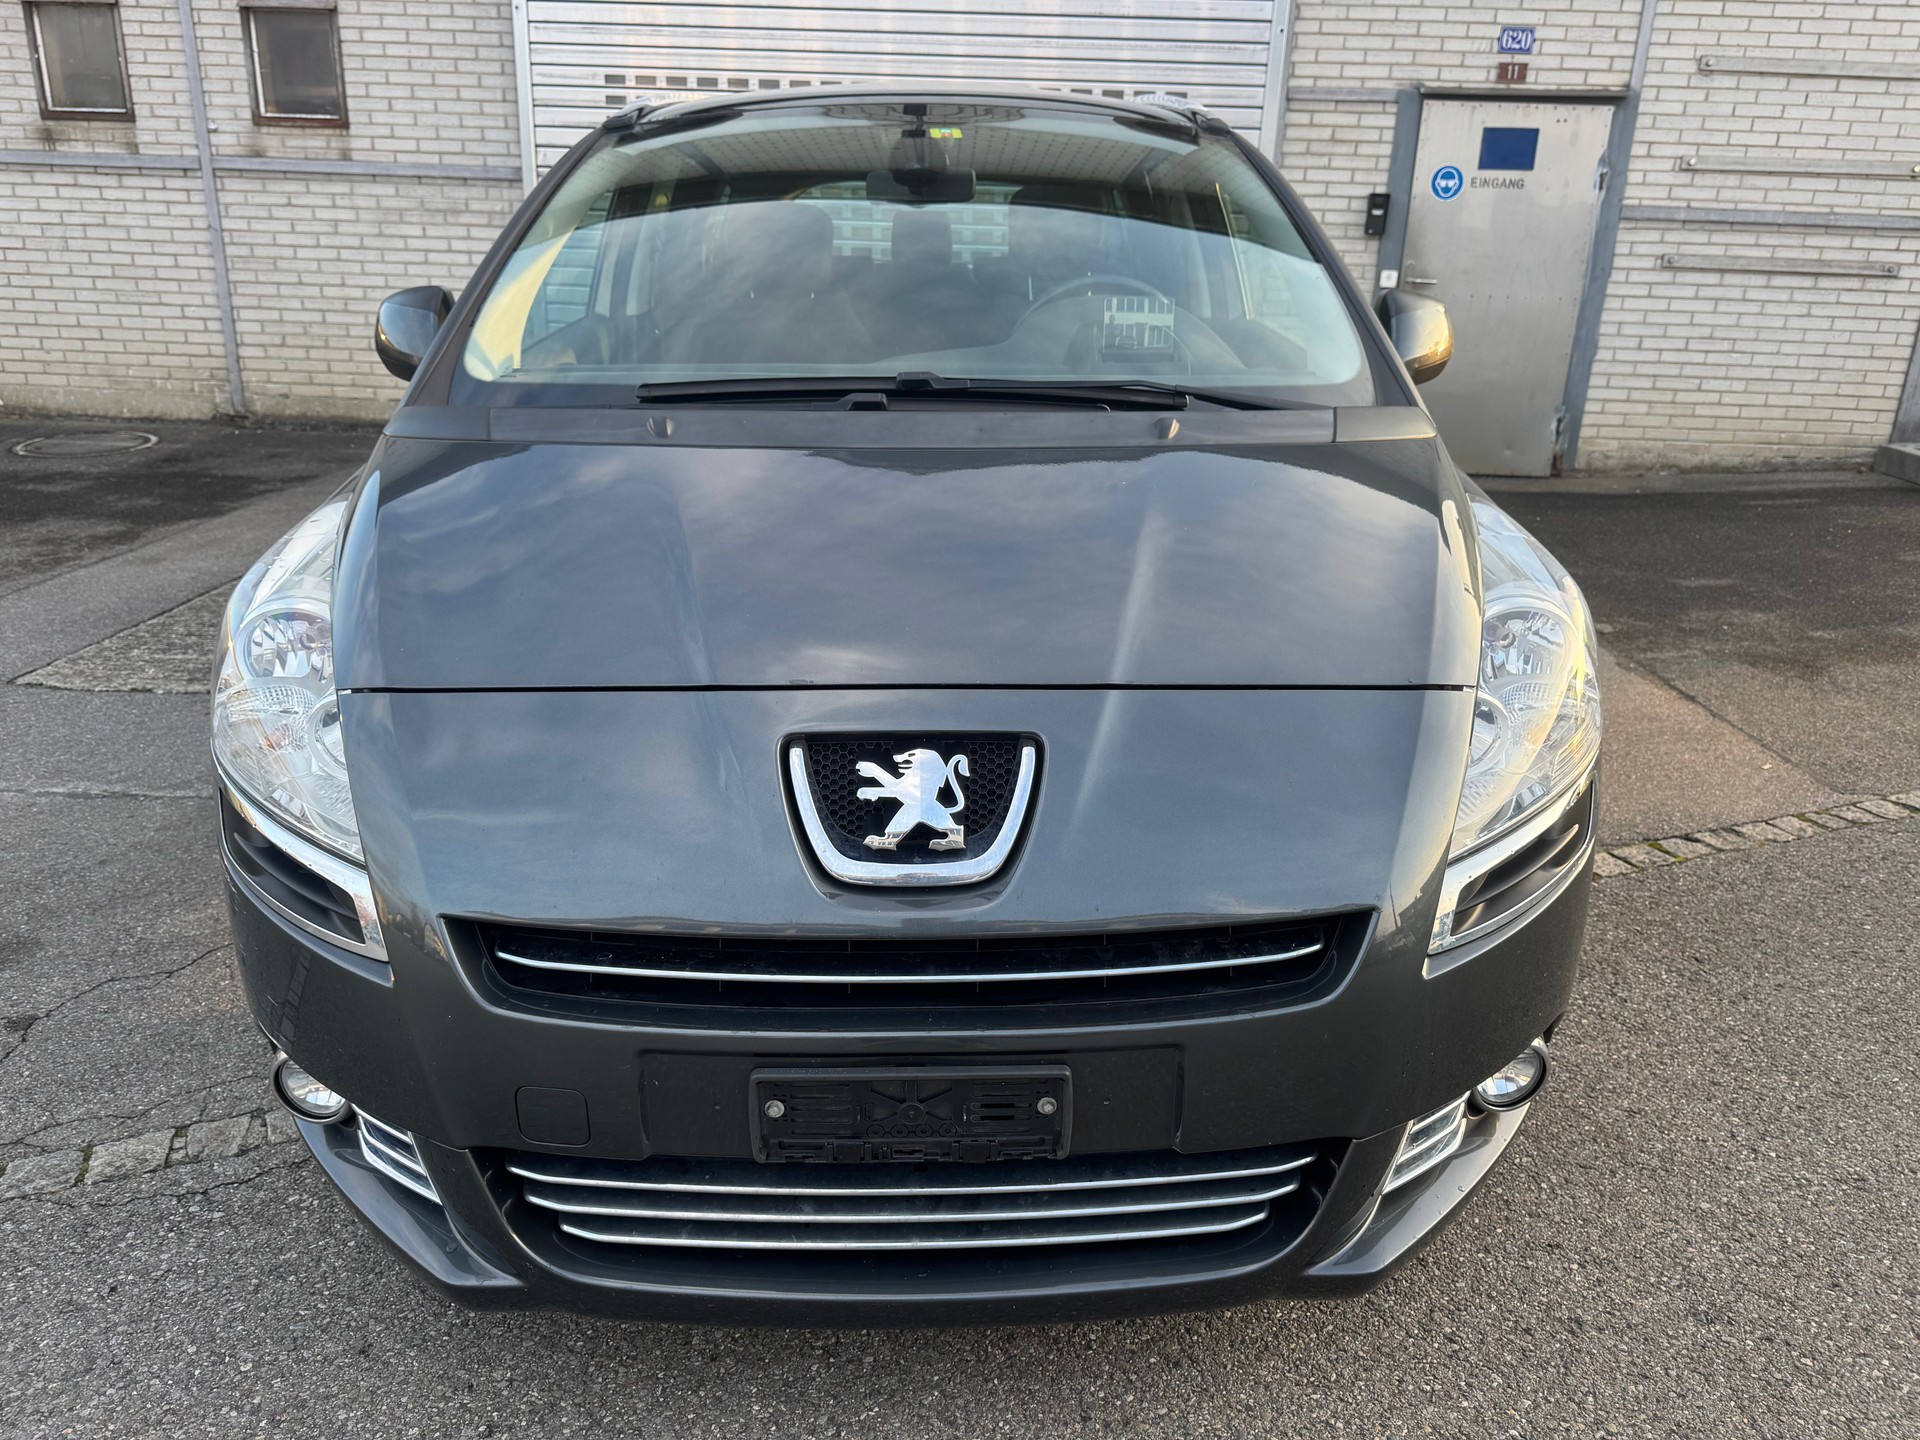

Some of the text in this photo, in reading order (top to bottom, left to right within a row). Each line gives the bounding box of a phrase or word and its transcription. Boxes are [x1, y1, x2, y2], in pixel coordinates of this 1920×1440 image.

[1502, 30, 1532, 50] 620
[1507, 64, 1519, 80] 11
[1470, 176, 1525, 190] EINGANG
